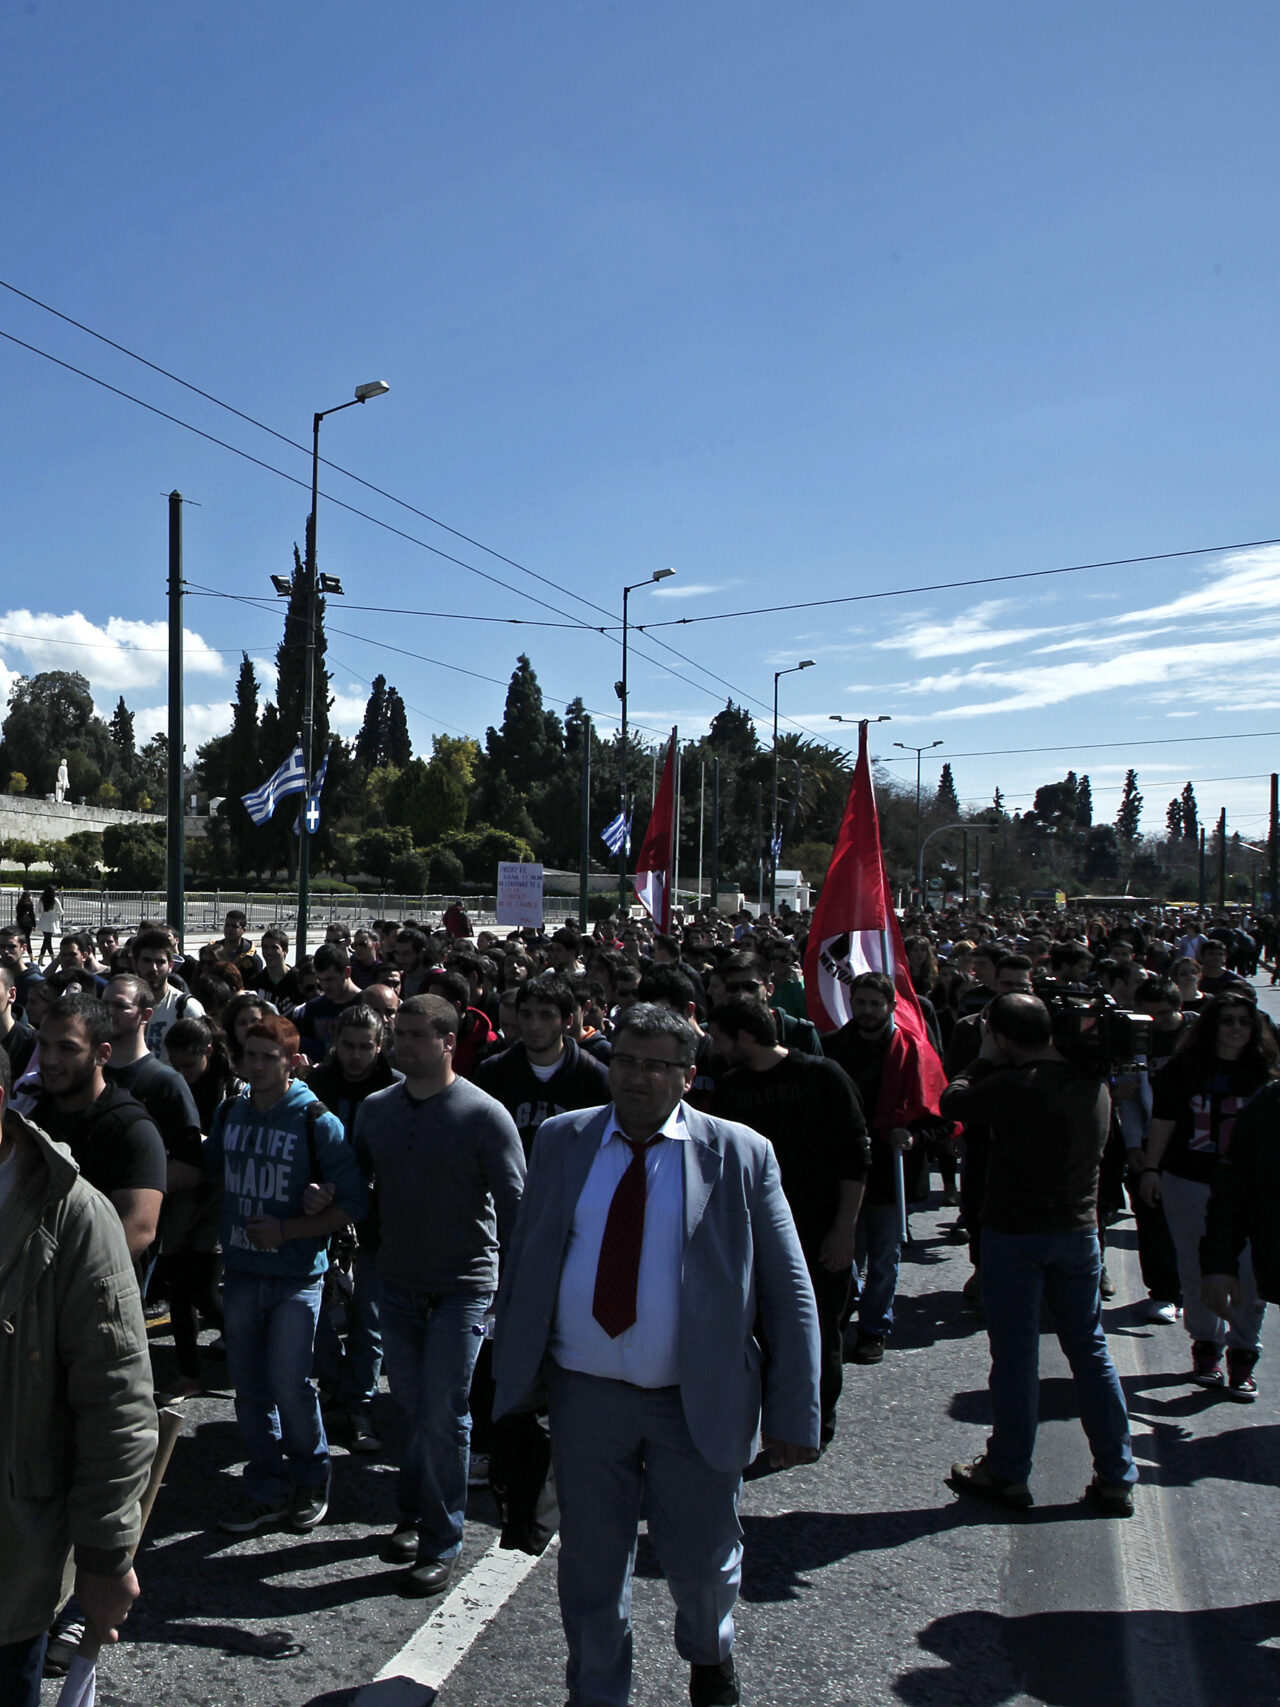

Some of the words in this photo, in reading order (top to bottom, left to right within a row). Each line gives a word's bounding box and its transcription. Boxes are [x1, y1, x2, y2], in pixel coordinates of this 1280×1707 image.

[223, 1123, 252, 1153] MY
[254, 1127, 298, 1161] LIFE
[224, 1155, 292, 1202] MADE
[238, 1197, 252, 1217] TO
[256, 1200, 265, 1217] A
